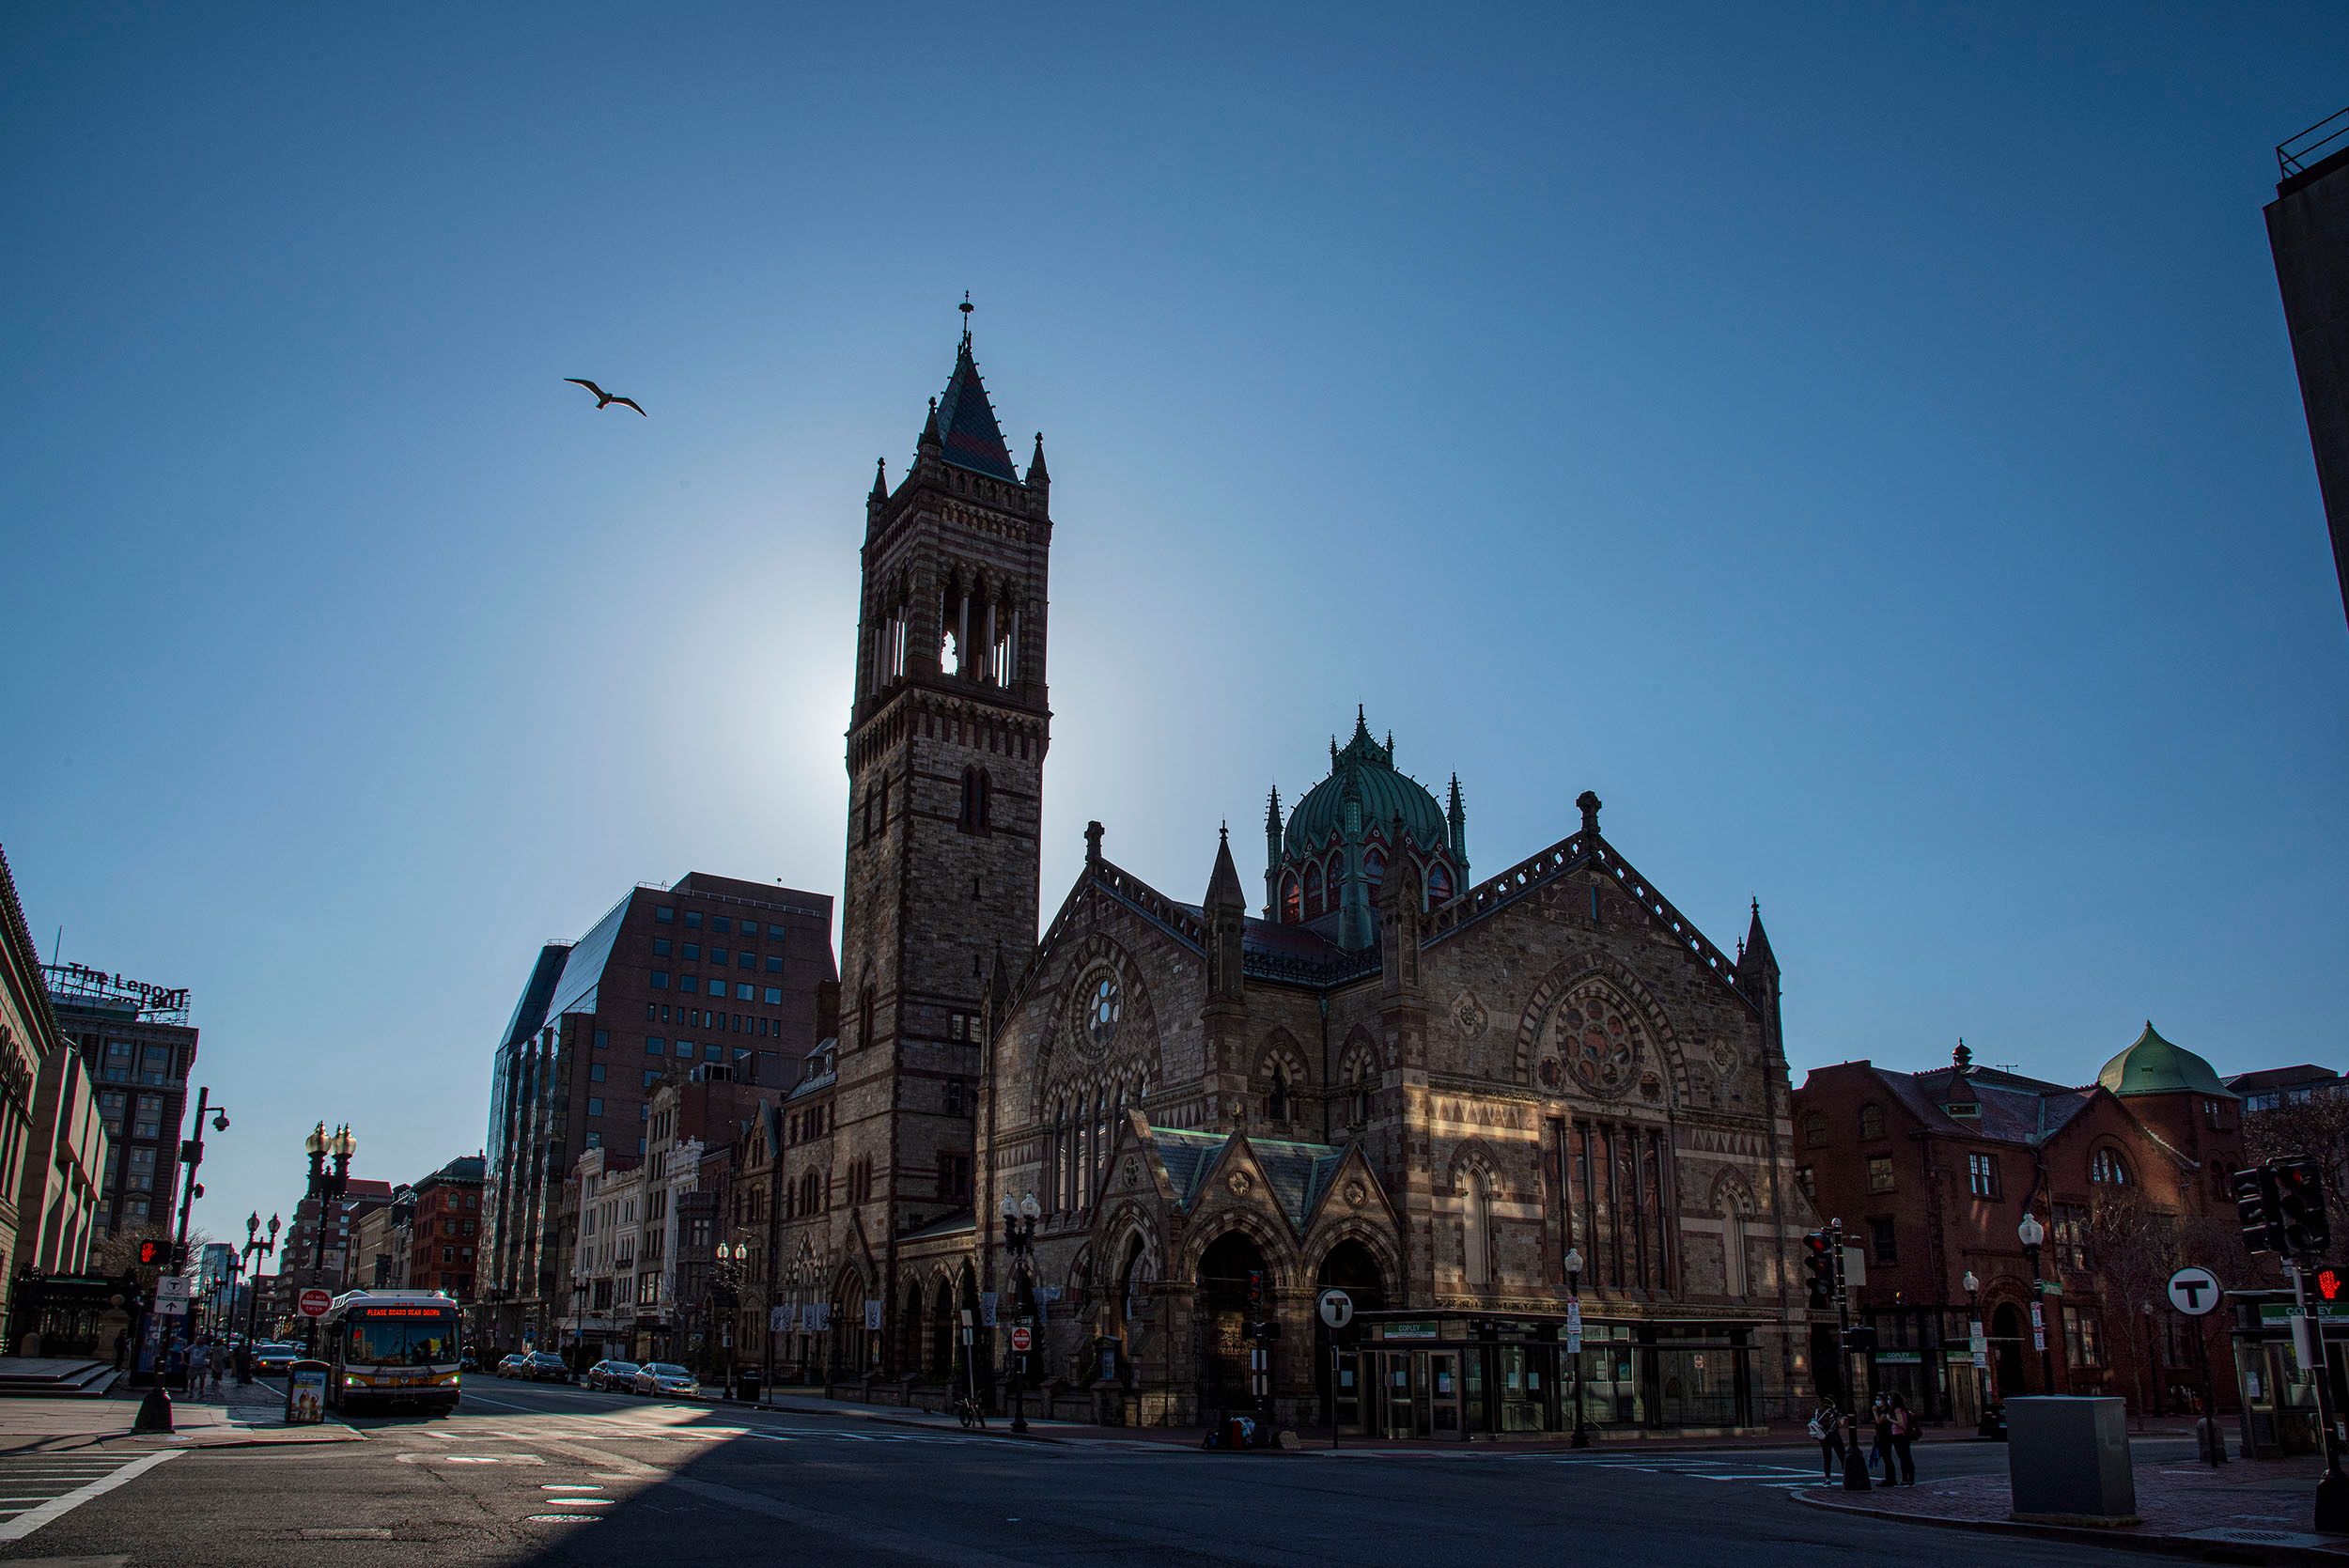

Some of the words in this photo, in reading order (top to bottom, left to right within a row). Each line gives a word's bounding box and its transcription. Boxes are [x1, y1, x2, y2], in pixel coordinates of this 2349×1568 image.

[69, 962, 109, 986] The
[115, 973, 177, 999] Lenox
[2174, 1281, 2210, 1308] T
[1326, 1297, 1348, 1321] T
[2286, 1307, 2332, 1315] COEY
[1398, 1324, 1421, 1332] COPLEY
